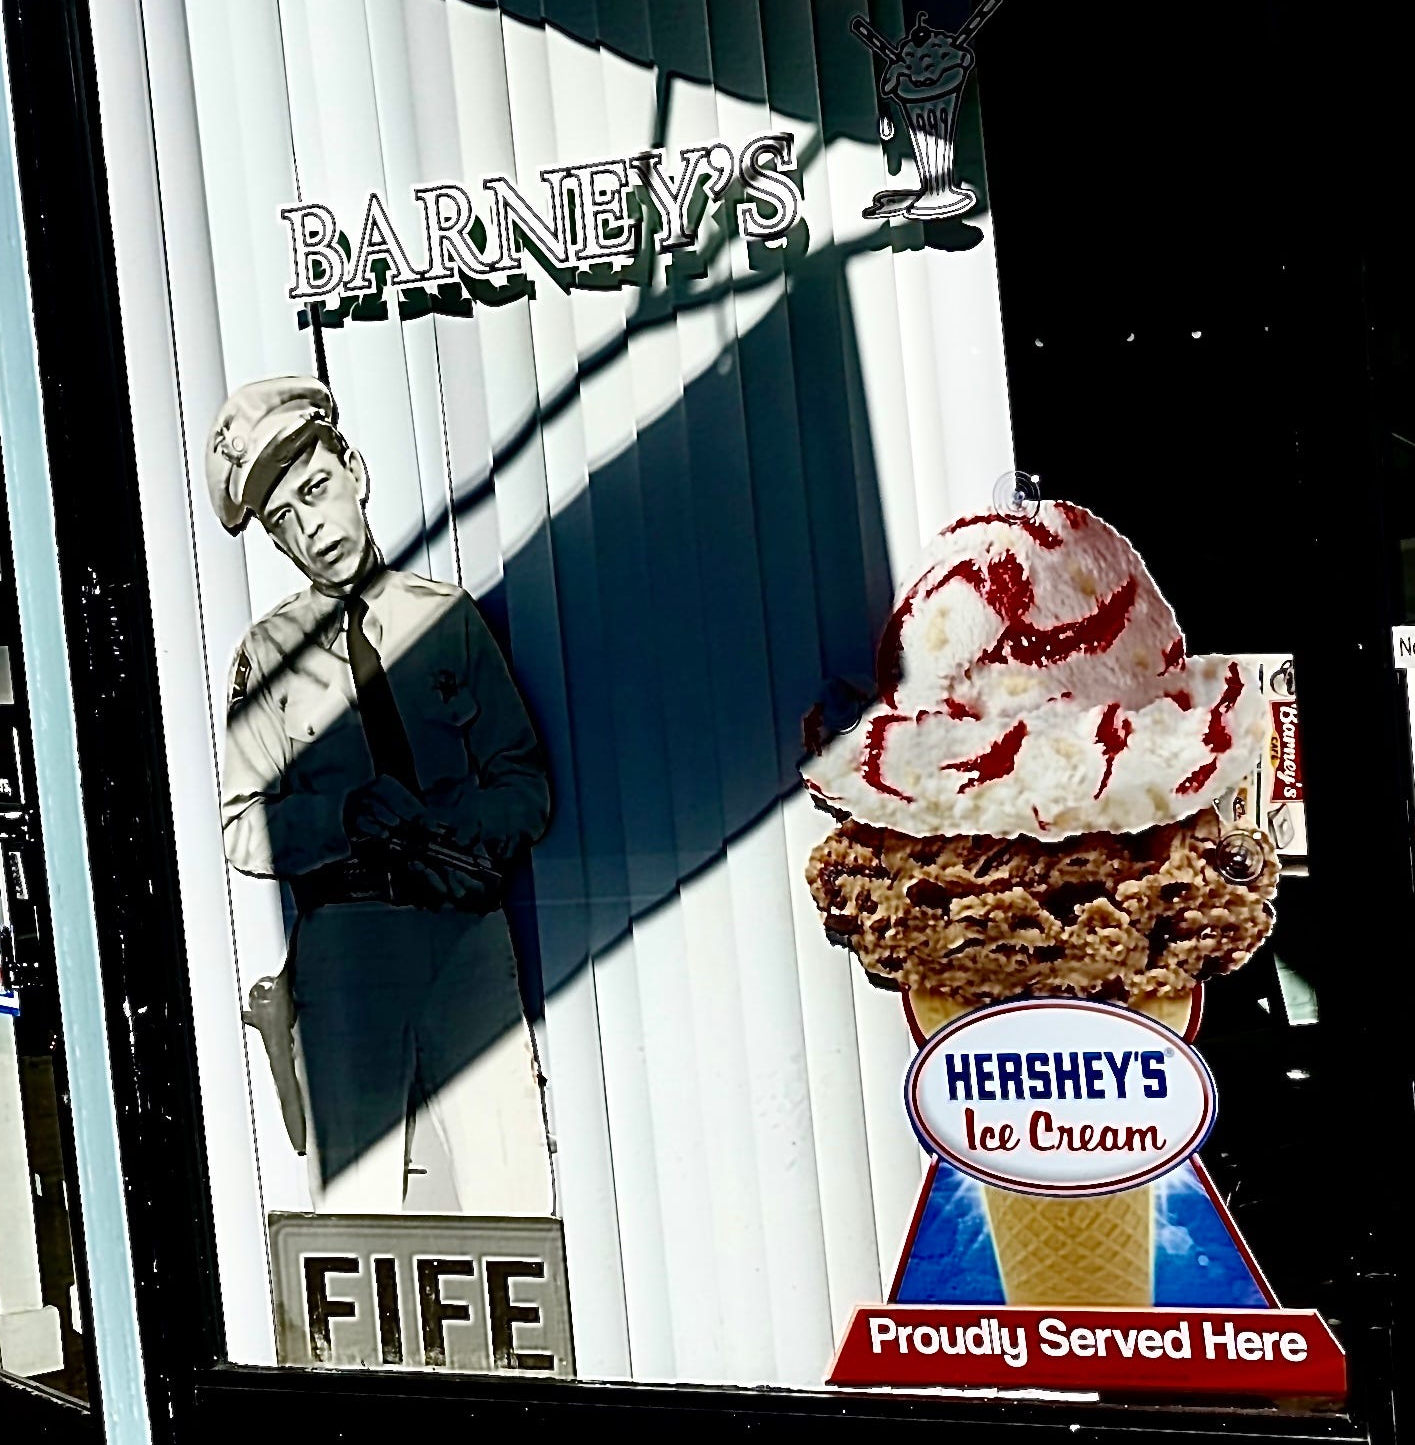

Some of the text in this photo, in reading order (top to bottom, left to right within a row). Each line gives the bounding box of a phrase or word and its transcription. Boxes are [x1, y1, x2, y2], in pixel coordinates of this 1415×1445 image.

[281, 133, 802, 299] BARNEY'S
[1277, 703, 1304, 799] Barney's
[944, 1050, 1168, 1101] HERSHEY'S
[964, 1108, 1167, 1152] Ice Cream
[303, 1256, 555, 1370] FIFE
[868, 1317, 1308, 1367] Proudly Served Here
